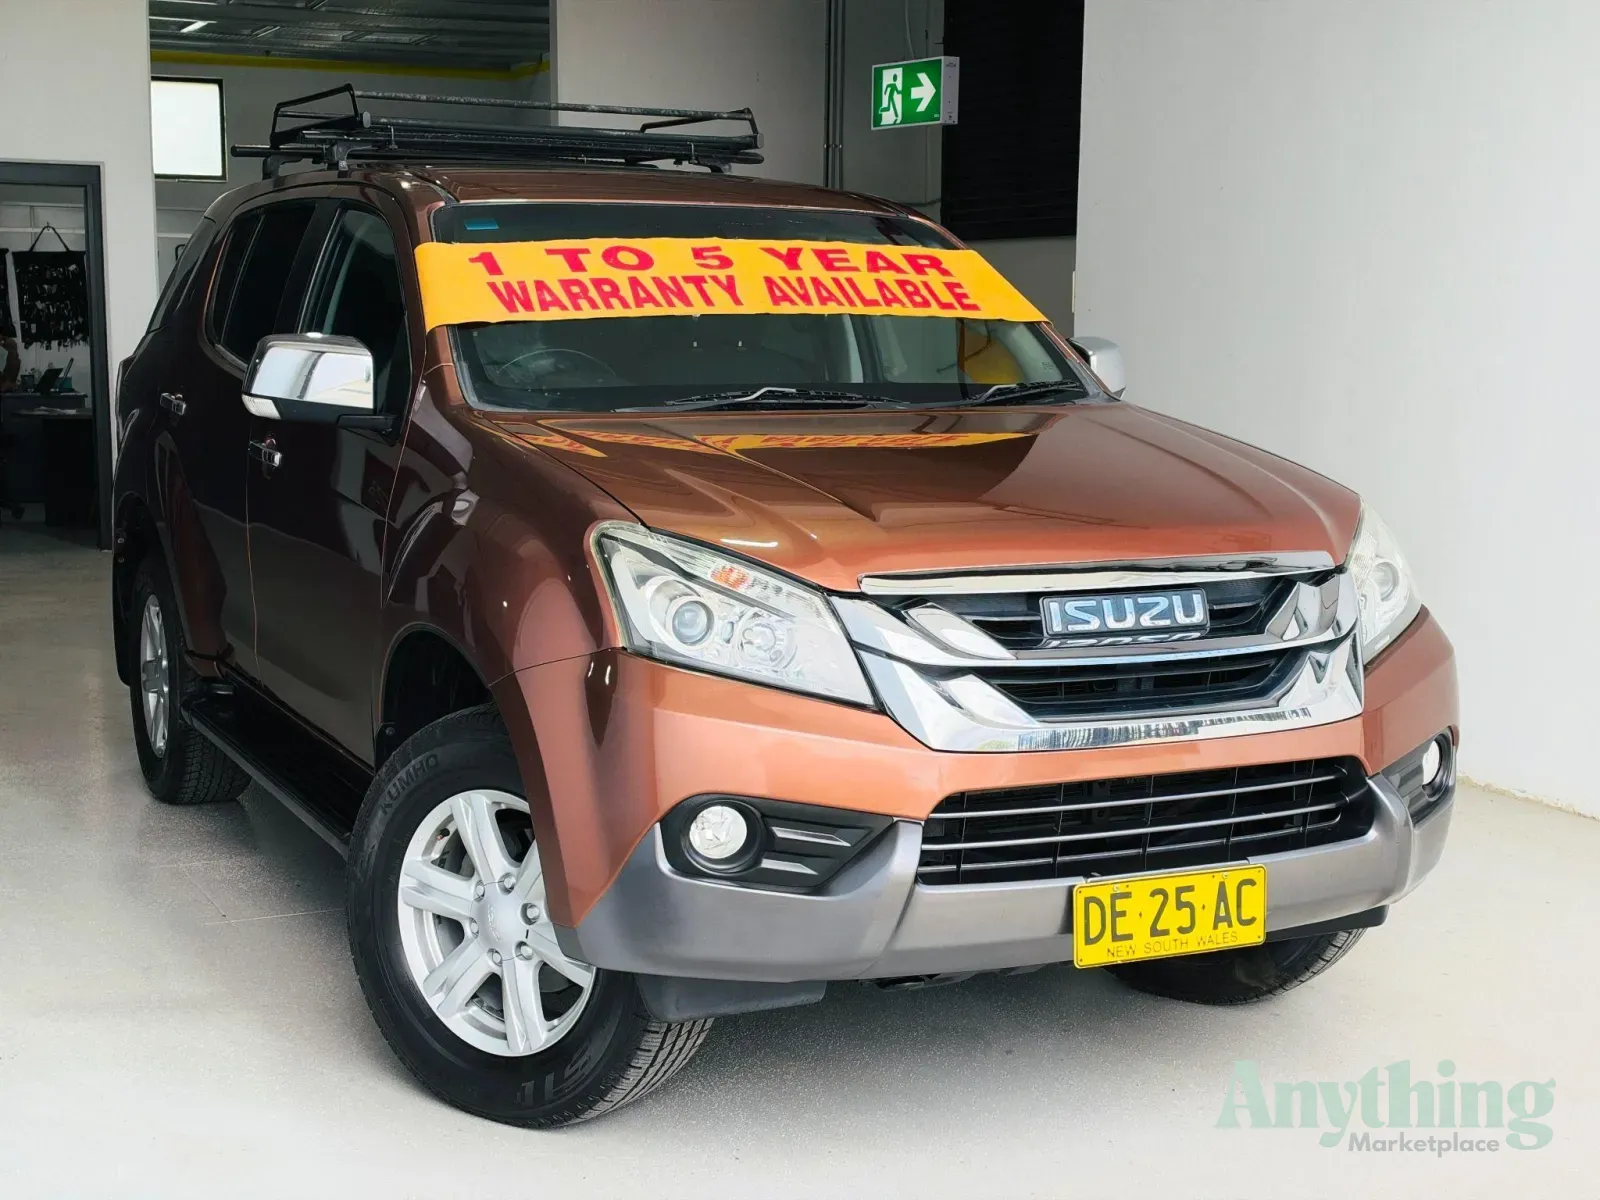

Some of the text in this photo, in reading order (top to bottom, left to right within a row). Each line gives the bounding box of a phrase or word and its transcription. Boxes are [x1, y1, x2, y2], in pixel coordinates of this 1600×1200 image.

[468, 245, 956, 278] 1 TO 5 YEAR
[486, 275, 982, 314] WARRANTY AVAILABLE
[1049, 594, 1205, 632] ISUZU
[379, 753, 439, 816] KUMHO
[1106, 931, 1238, 958] NEW SOUTH WALES
